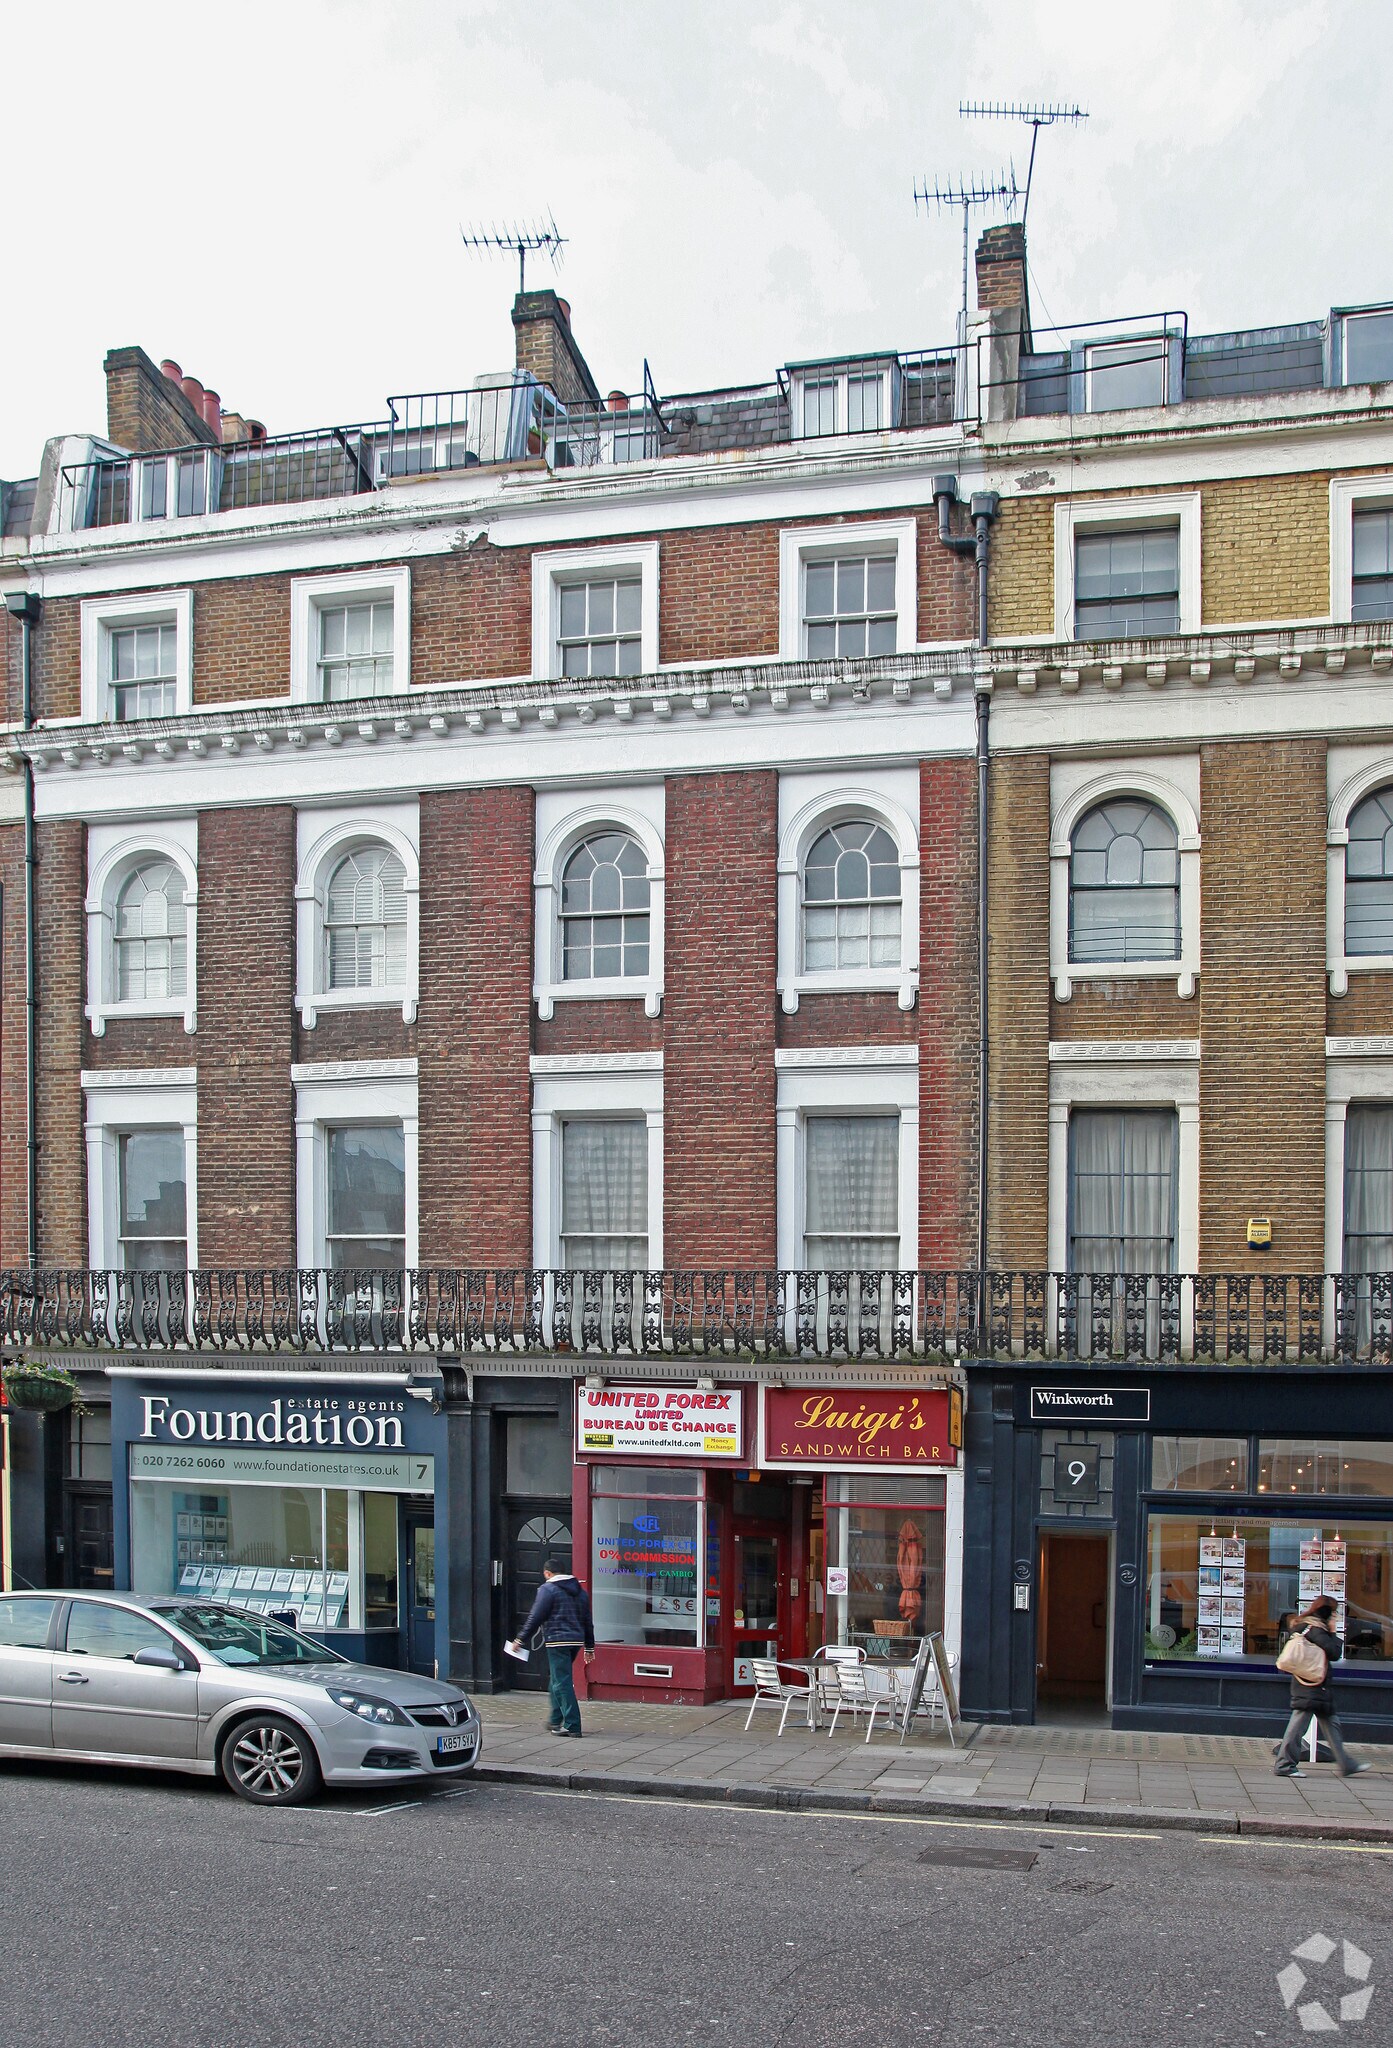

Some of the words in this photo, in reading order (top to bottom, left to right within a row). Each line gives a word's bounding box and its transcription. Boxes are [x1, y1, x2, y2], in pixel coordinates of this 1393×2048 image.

[579, 1389, 586, 1398] 8
[588, 1392, 660, 1408] UNITED
[665, 1393, 732, 1410] FOREX
[1036, 1392, 1114, 1406] Winkworth
[287, 1397, 339, 1410] estate
[347, 1400, 404, 1414] agents
[139, 1396, 406, 1448] Foundation
[634, 1409, 684, 1420] LIMITED
[794, 1395, 926, 1444] Luigi's
[583, 1419, 645, 1432] BUREAU
[648, 1420, 669, 1432] DE
[671, 1421, 737, 1434] CHANGE
[617, 1438, 702, 1448] www.unitedfxltd.com
[780, 1442, 890, 1457] SANDWICH
[904, 1445, 941, 1458] BAR
[142, 1456, 164, 1466] 020
[166, 1456, 194, 1467] 7262
[196, 1457, 225, 1469] 6060
[233, 1459, 399, 1476] www.foundationestates.co.uk
[416, 1464, 428, 1480] 7
[1067, 1460, 1087, 1486] 9
[1255, 1518, 1300, 1527] management
[541, 1537, 547, 1545] 8
[597, 1537, 636, 1547] UNITED
[639, 1538, 675, 1549] FOREX
[677, 1540, 697, 1551] LTD
[599, 1549, 622, 1561] 0%
[623, 1551, 696, 1565] COMMISSION
[659, 1569, 694, 1578] CAMBIO
[672, 1598, 681, 1612] $
[685, 1599, 695, 1612] €
[738, 1664, 748, 1679] £
[443, 1736, 461, 1750] KB57
